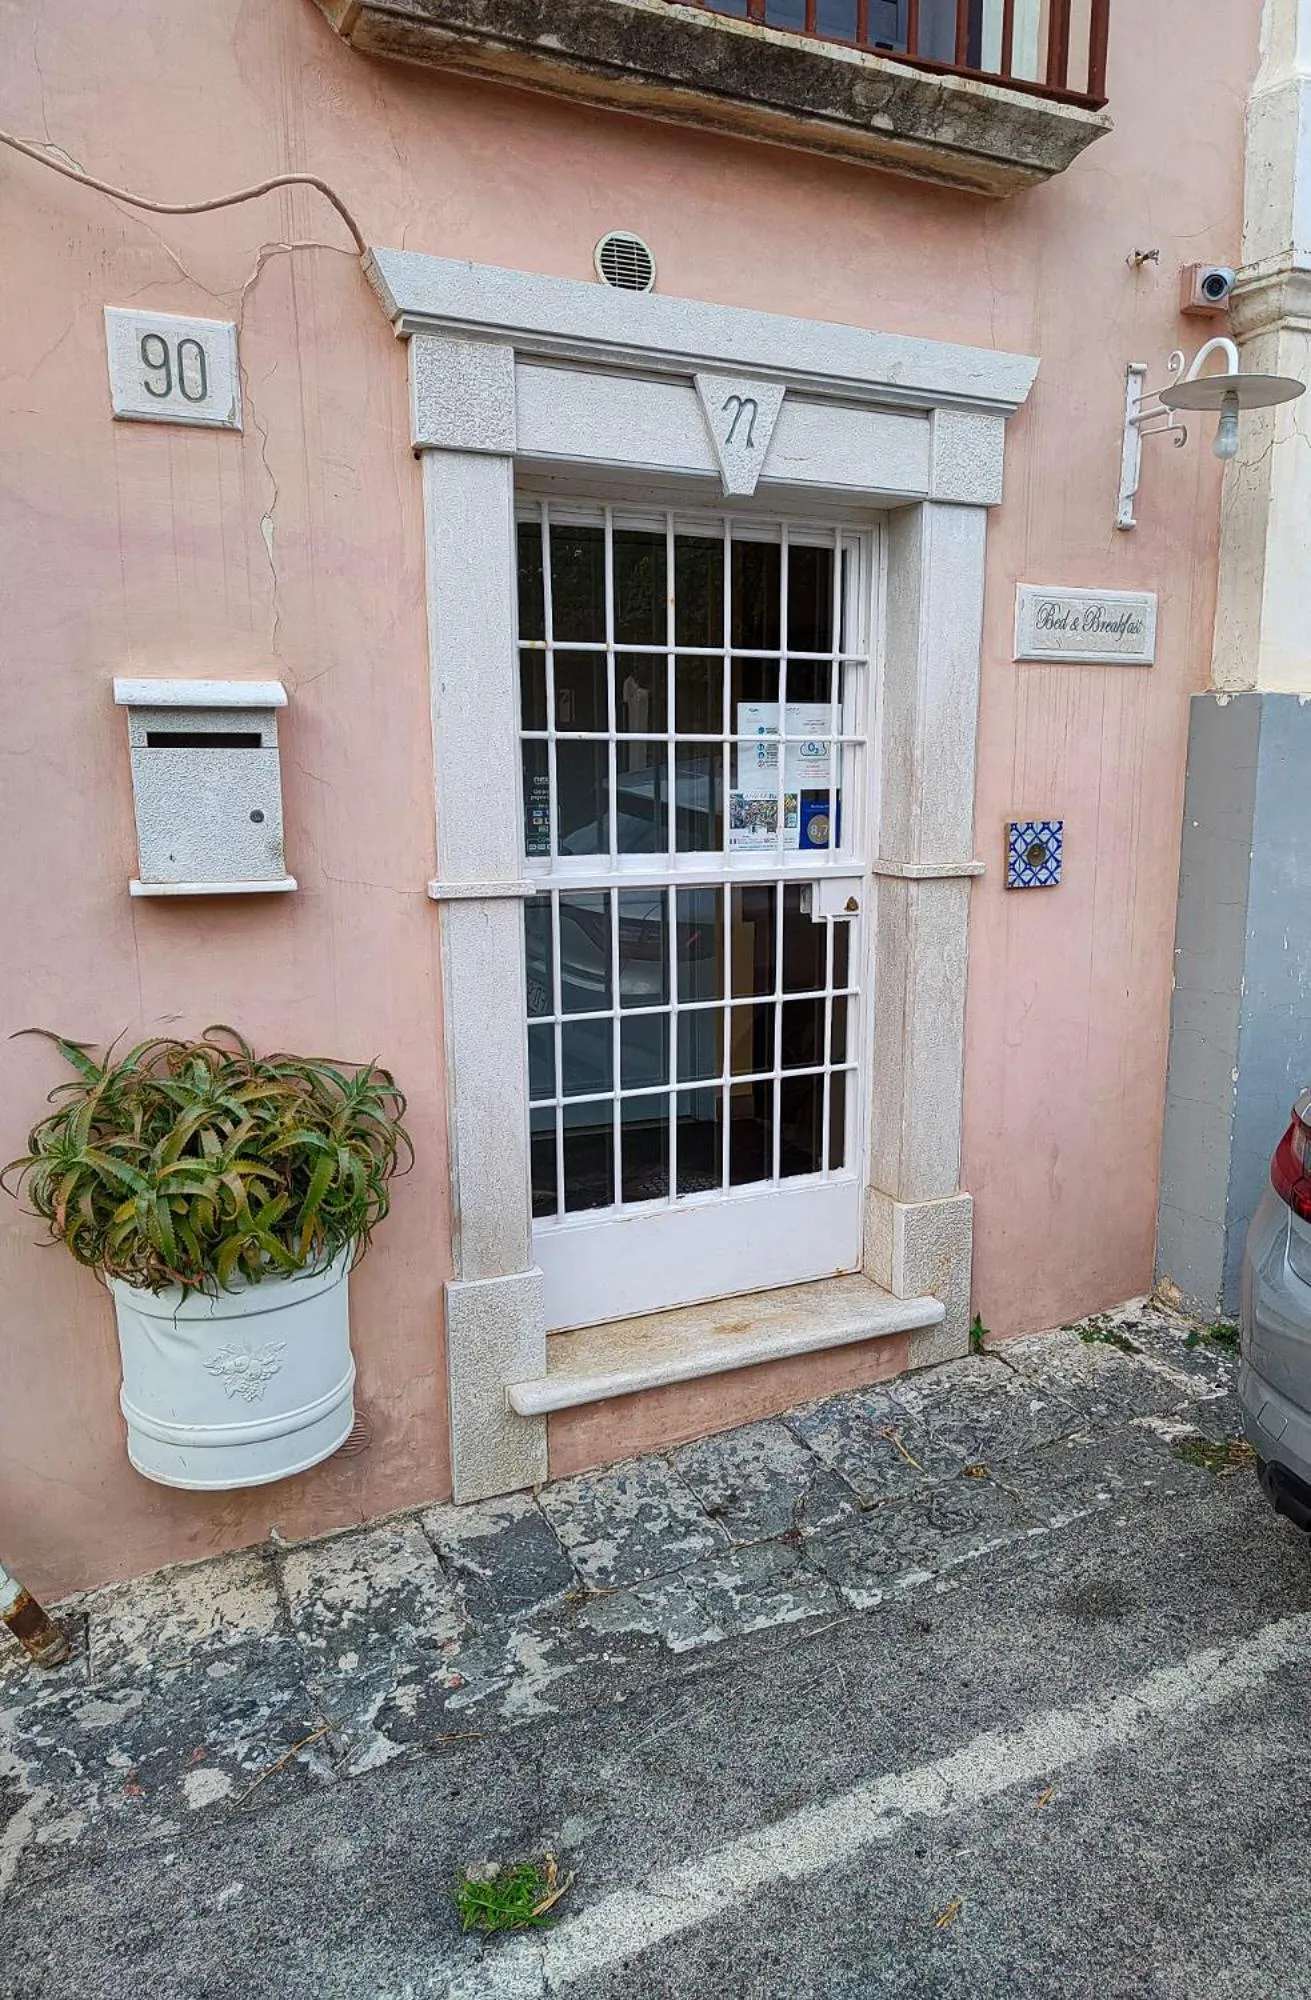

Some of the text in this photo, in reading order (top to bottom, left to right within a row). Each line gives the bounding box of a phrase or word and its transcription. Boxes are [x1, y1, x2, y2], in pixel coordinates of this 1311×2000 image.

[140, 333, 208, 403] 90
[1035, 602, 1070, 631] Bed
[1071, 616, 1079, 632] &
